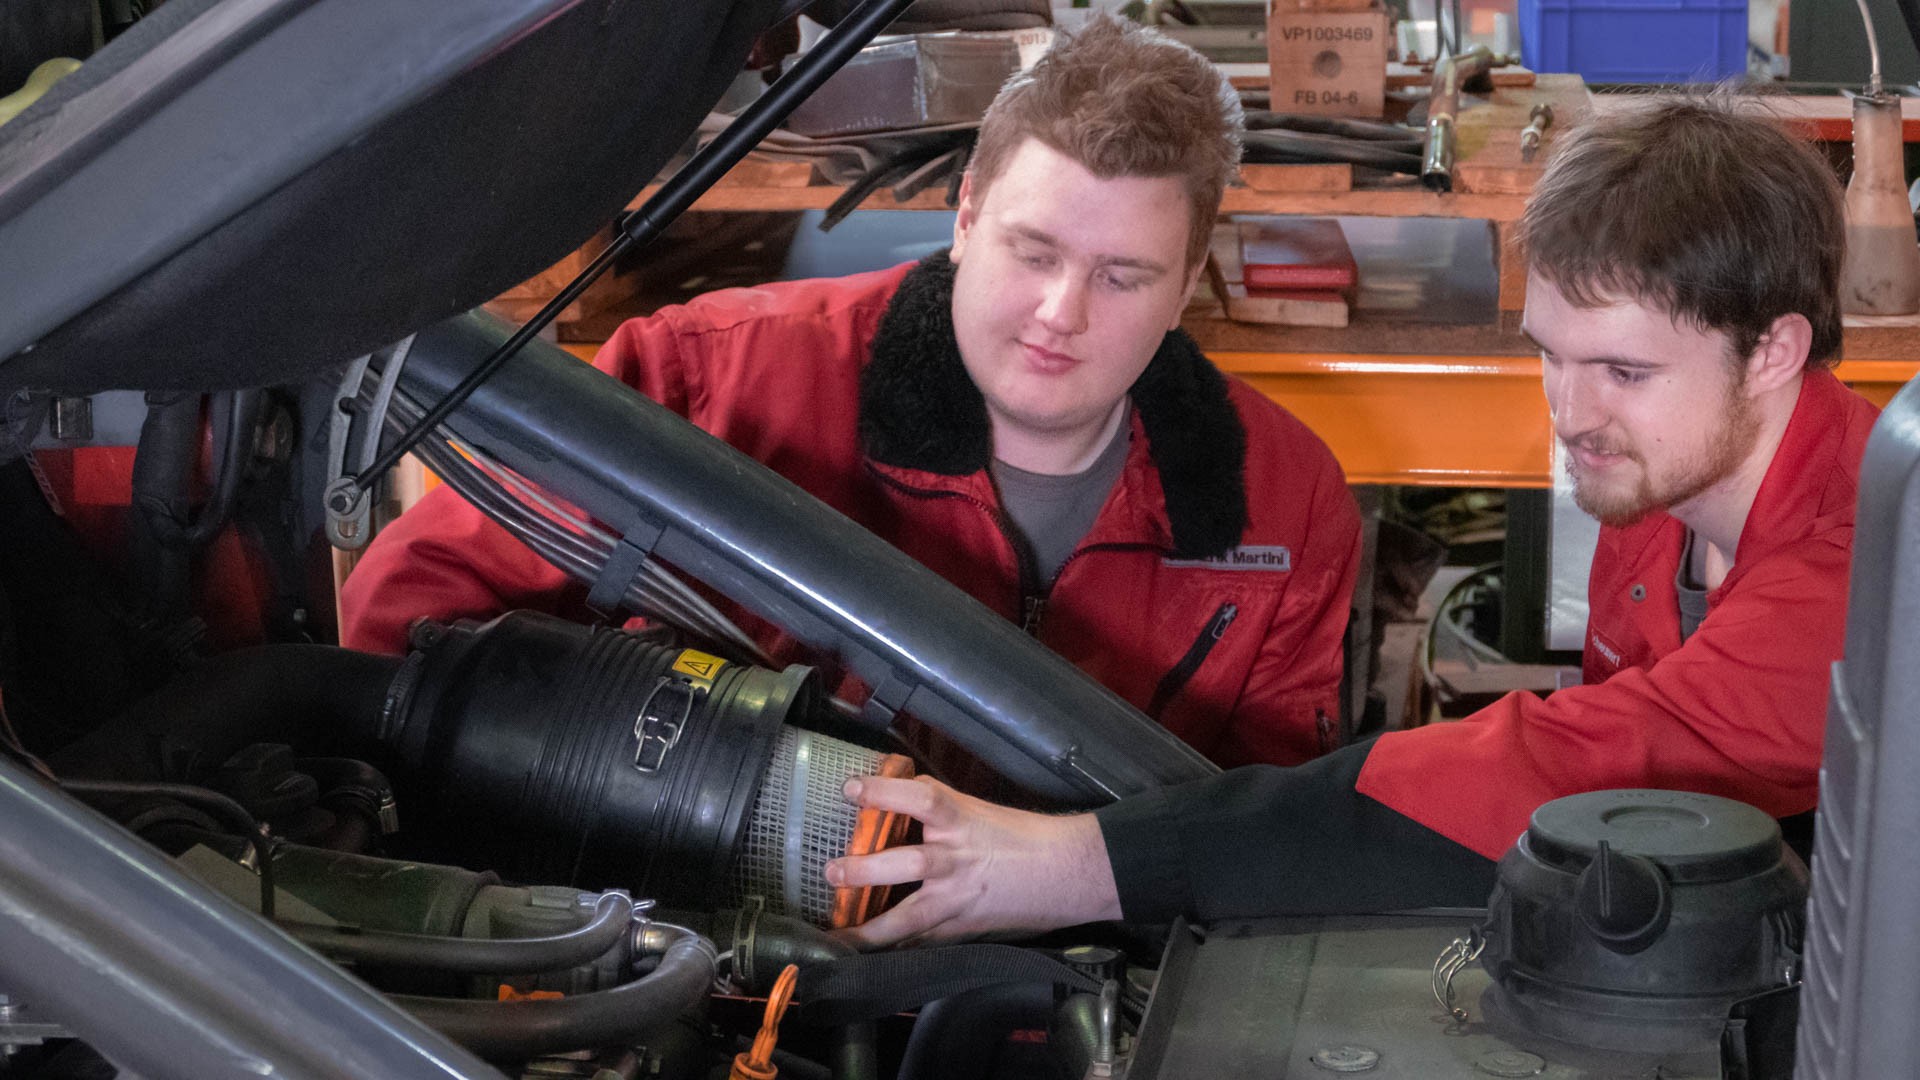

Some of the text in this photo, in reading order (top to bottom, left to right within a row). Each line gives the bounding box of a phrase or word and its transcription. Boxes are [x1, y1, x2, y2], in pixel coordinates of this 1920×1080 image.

[1281, 26, 1374, 42] VP1003469
[1294, 89, 1359, 105] FB 04-6
[1232, 551, 1285, 566] Martini
